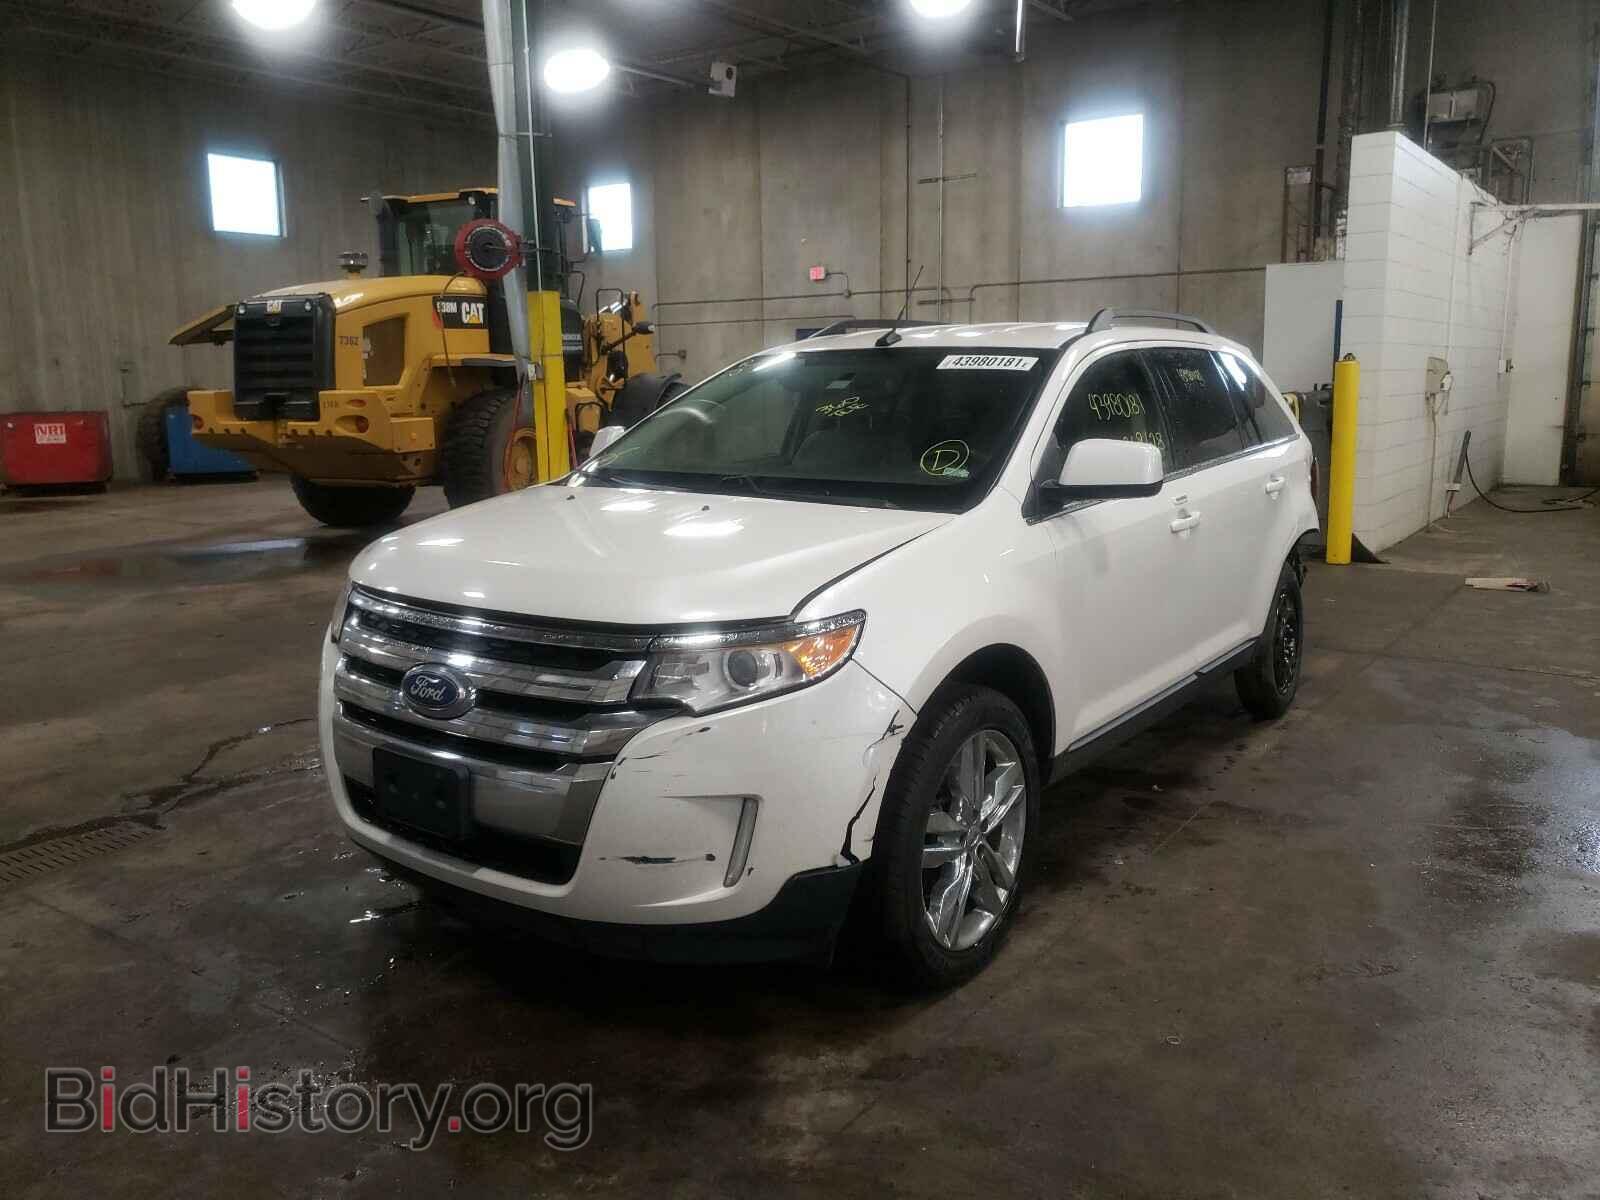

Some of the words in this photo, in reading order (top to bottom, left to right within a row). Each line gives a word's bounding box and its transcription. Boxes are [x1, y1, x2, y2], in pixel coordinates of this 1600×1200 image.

[461, 302, 484, 324] CAT
[952, 356, 1023, 368] 43980181
[410, 675, 447, 701] Ford
